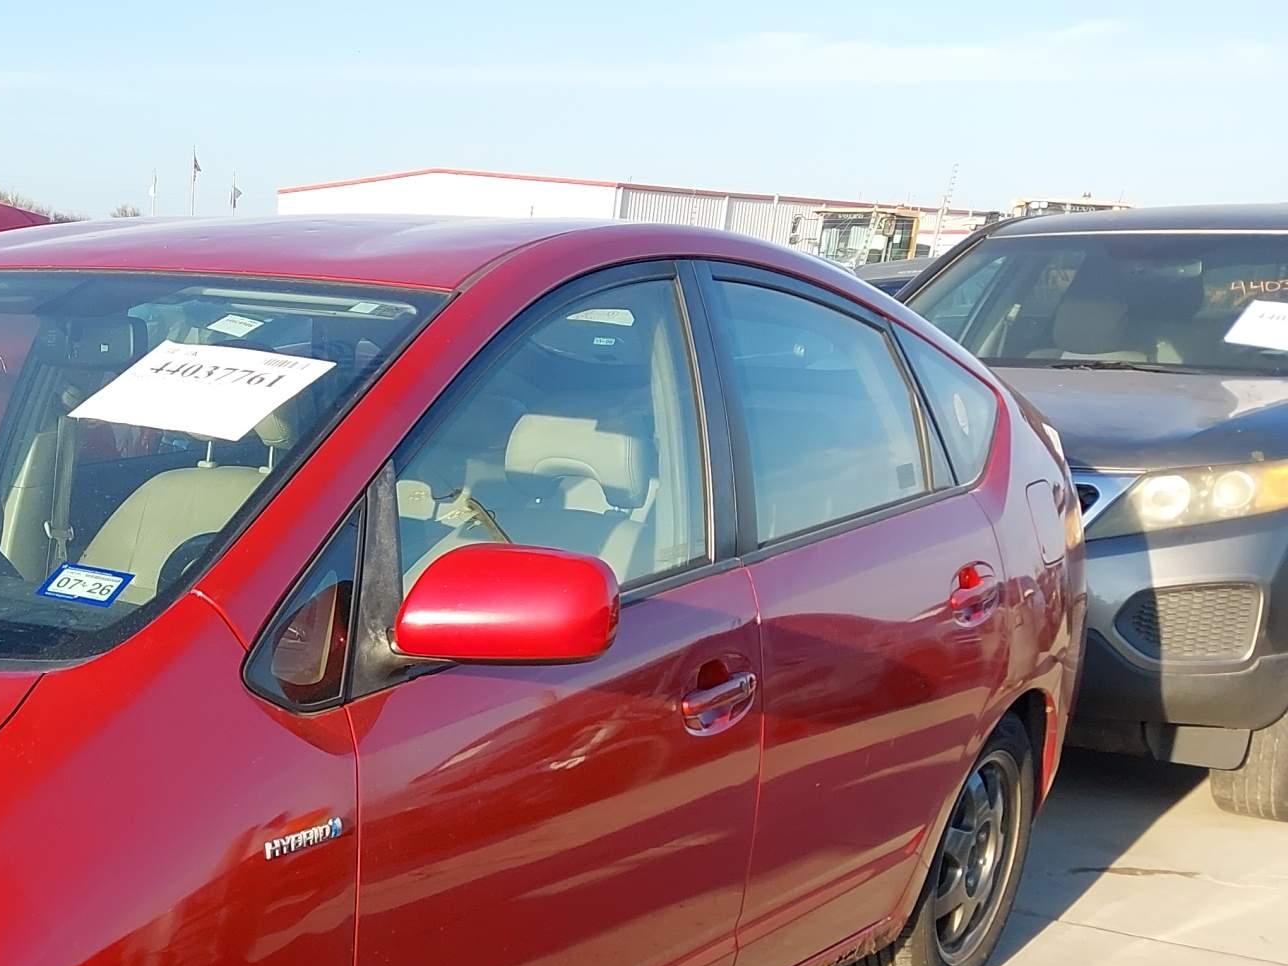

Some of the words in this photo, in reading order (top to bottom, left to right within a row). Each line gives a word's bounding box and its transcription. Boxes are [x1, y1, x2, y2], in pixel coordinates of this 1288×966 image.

[150, 361, 286, 388] 44037761
[86, 583, 114, 596] 26
[264, 824, 331, 860] HYBRID
